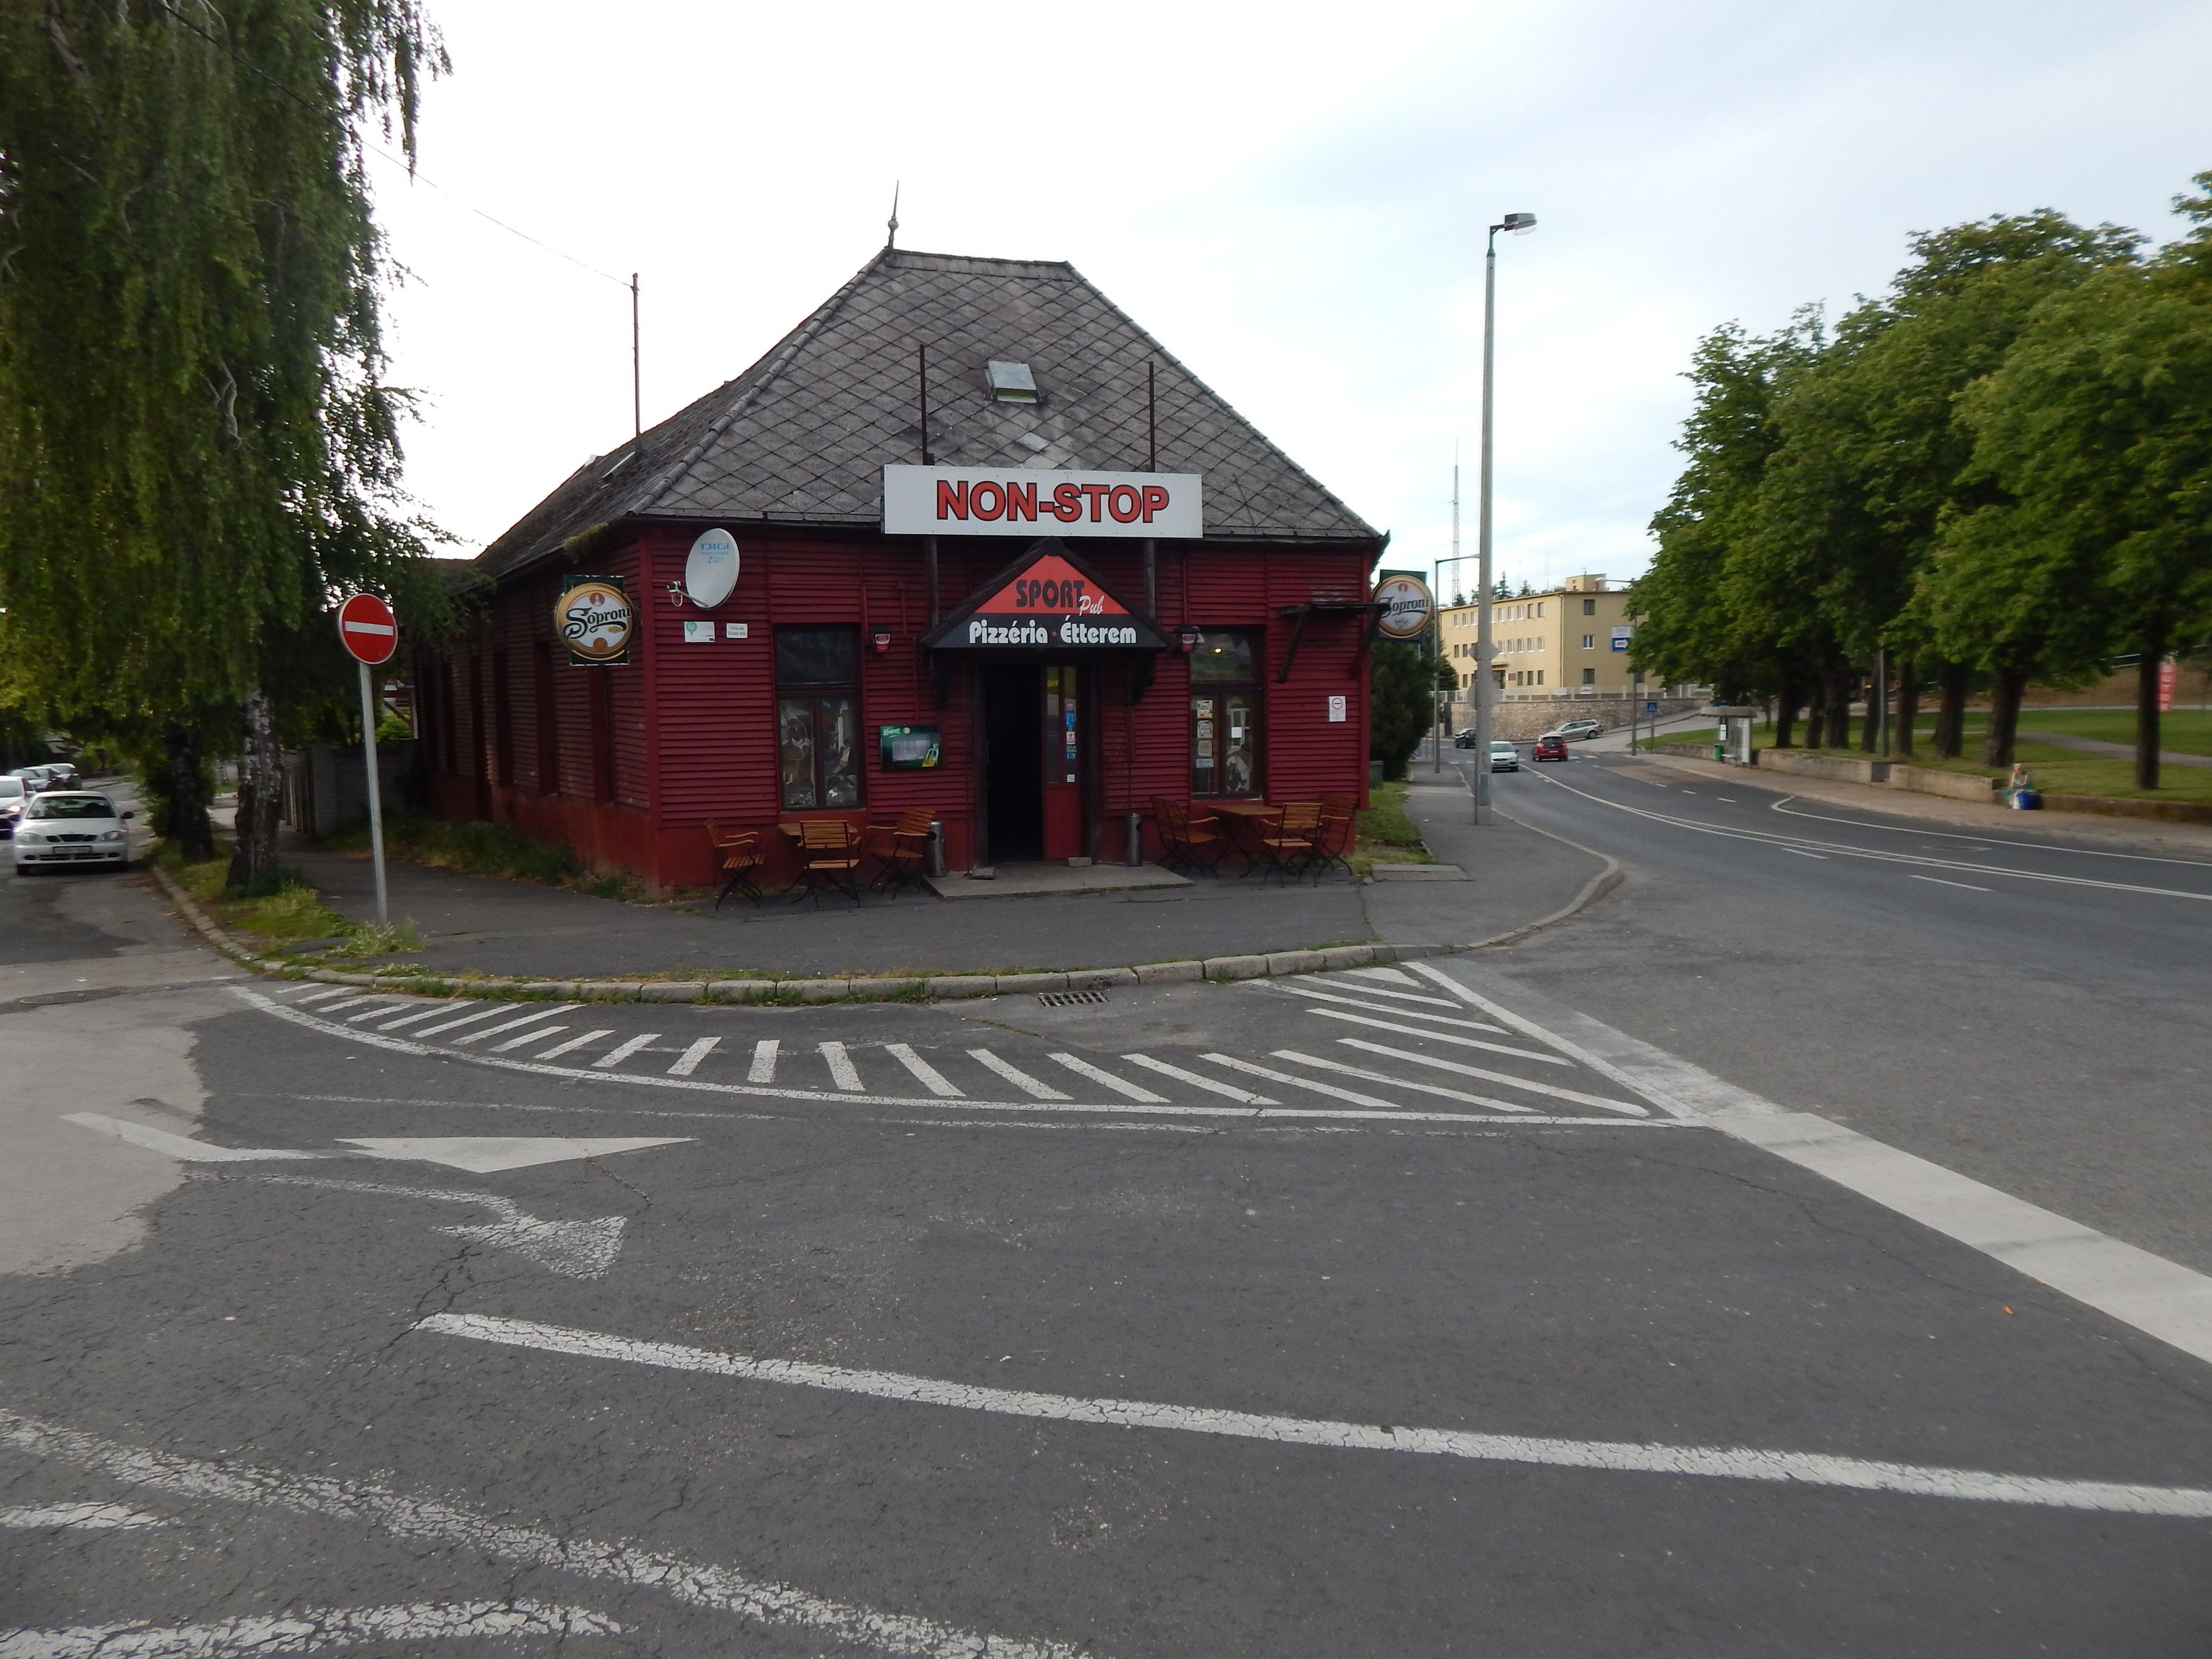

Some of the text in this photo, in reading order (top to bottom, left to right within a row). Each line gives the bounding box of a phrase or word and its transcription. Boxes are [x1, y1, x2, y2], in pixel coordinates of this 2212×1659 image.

[937, 480, 1169, 523] NON-STOP
[1016, 580, 1085, 608] SPORT
[1079, 595, 1104, 616] Pub
[563, 604, 631, 639] Soproni
[969, 616, 1137, 644] Pizzéria Étterem
